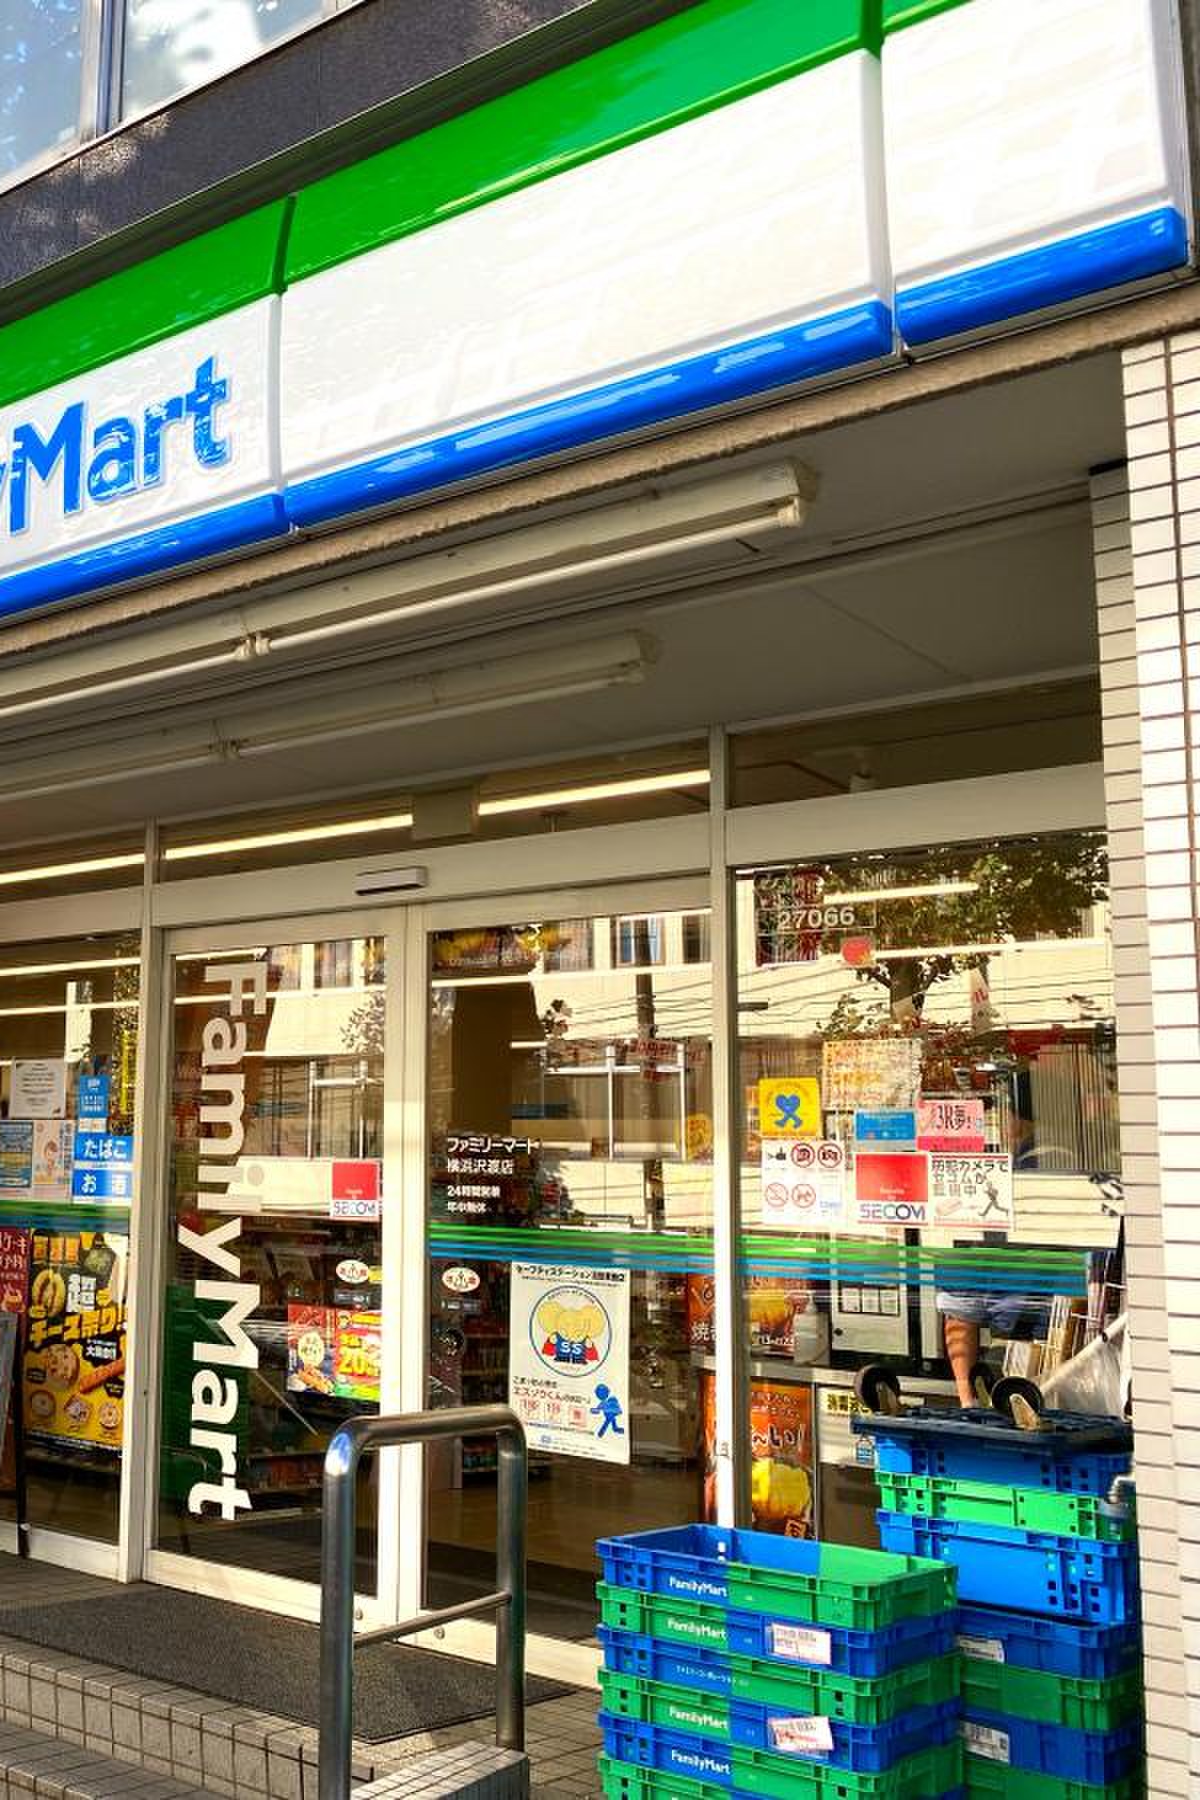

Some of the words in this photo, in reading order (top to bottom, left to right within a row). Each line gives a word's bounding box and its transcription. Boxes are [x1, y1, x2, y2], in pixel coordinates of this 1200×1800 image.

[777, 906, 856, 929] 27066
[83, 1139, 128, 1159] たばこ
[447, 1137, 541, 1154] ファミリーマート
[333, 1200, 378, 1217] SECOM
[859, 1202, 927, 1222] SECOM
[177, 961, 269, 1521] FamilyMart
[66, 1273, 98, 1313] 超
[559, 1341, 583, 1355] SS
[668, 1575, 728, 1598] FamilyMart
[667, 1618, 727, 1639] FamilyMart
[669, 1705, 729, 1730] FamilyMart
[671, 1749, 731, 1774] FamilyMart
